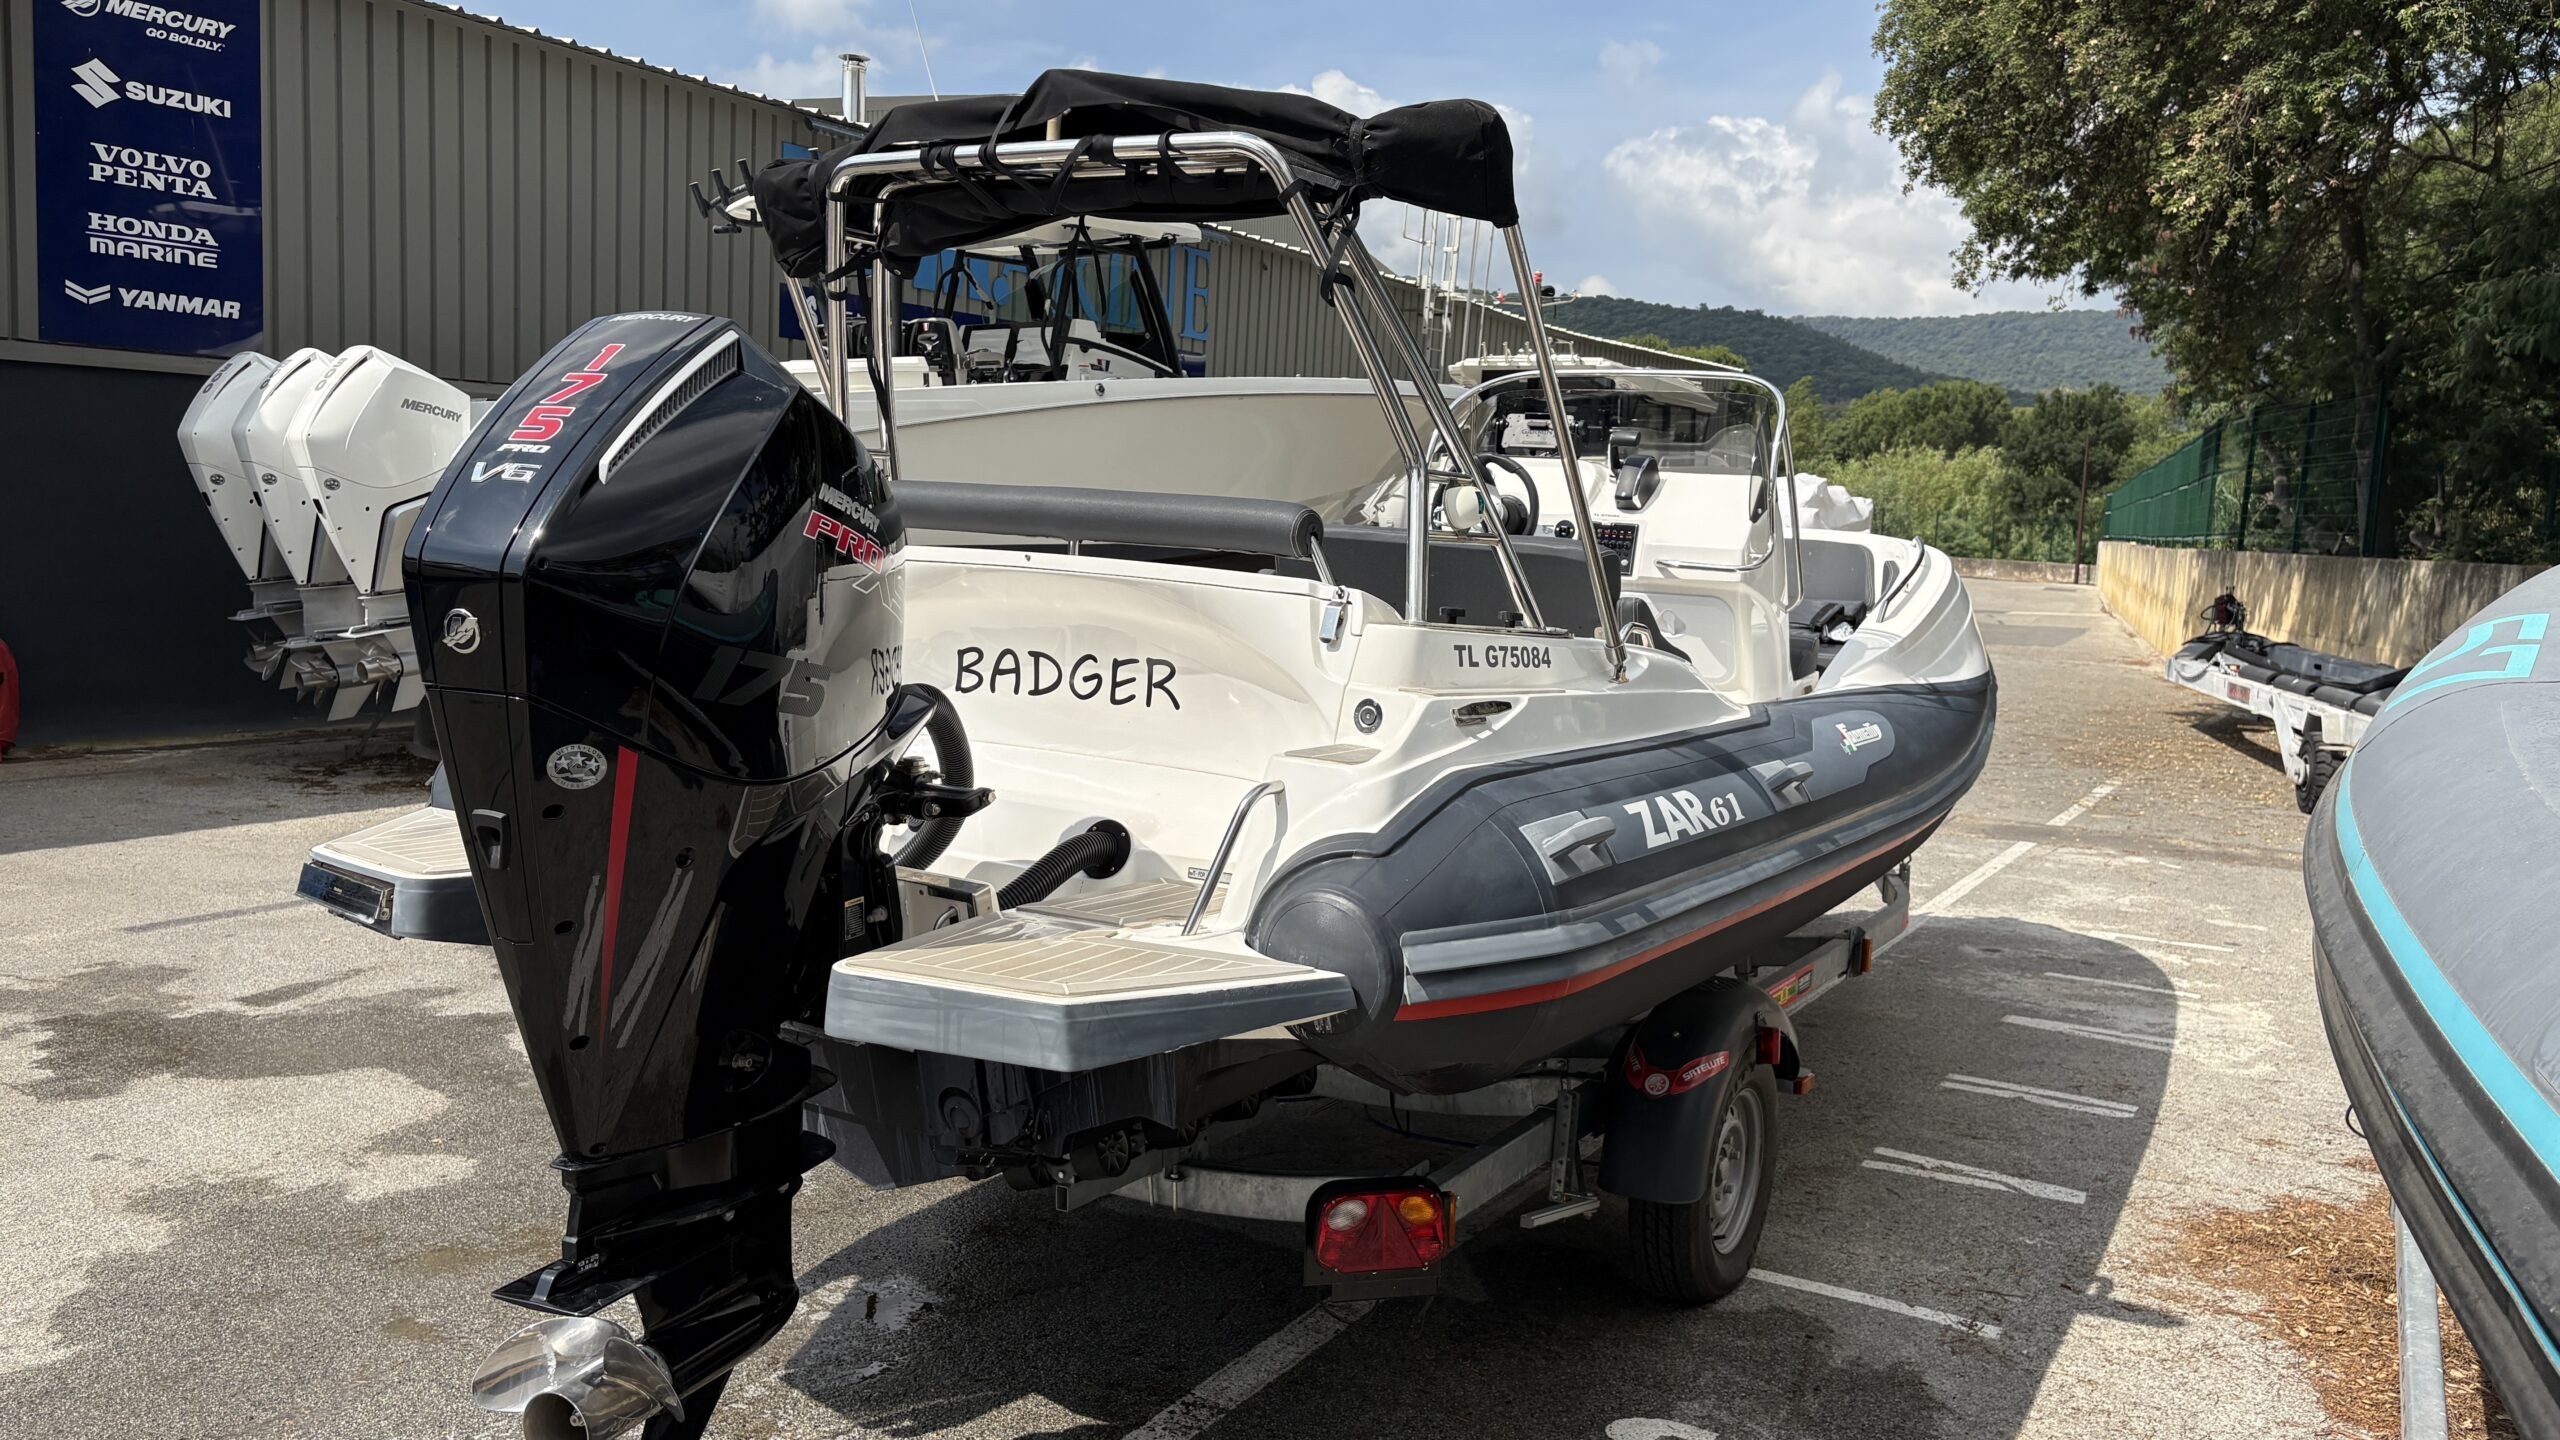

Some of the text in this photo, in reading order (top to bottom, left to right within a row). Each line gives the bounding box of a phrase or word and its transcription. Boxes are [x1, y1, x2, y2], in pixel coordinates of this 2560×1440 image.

[105, 0, 236, 39] MERCURY
[145, 28, 167, 39] GO
[125, 81, 231, 118] SUZUKI
[90, 142, 211, 178] VOLVO
[88, 162, 217, 199] PENTA
[88, 212, 218, 246] HONDA
[118, 287, 241, 319] YANMAR
[607, 312, 703, 323] MERCURY
[400, 398, 462, 422] MERCURY
[497, 443, 551, 454] PRO
[470, 462, 543, 484] V6
[818, 482, 880, 534] MERCURY
[803, 509, 885, 575] PRO
[1453, 645, 1552, 669] TL G75084
[692, 645, 832, 718] 175
[955, 646, 1181, 711] BADGER
[1622, 790, 1746, 849] ZAR 61
